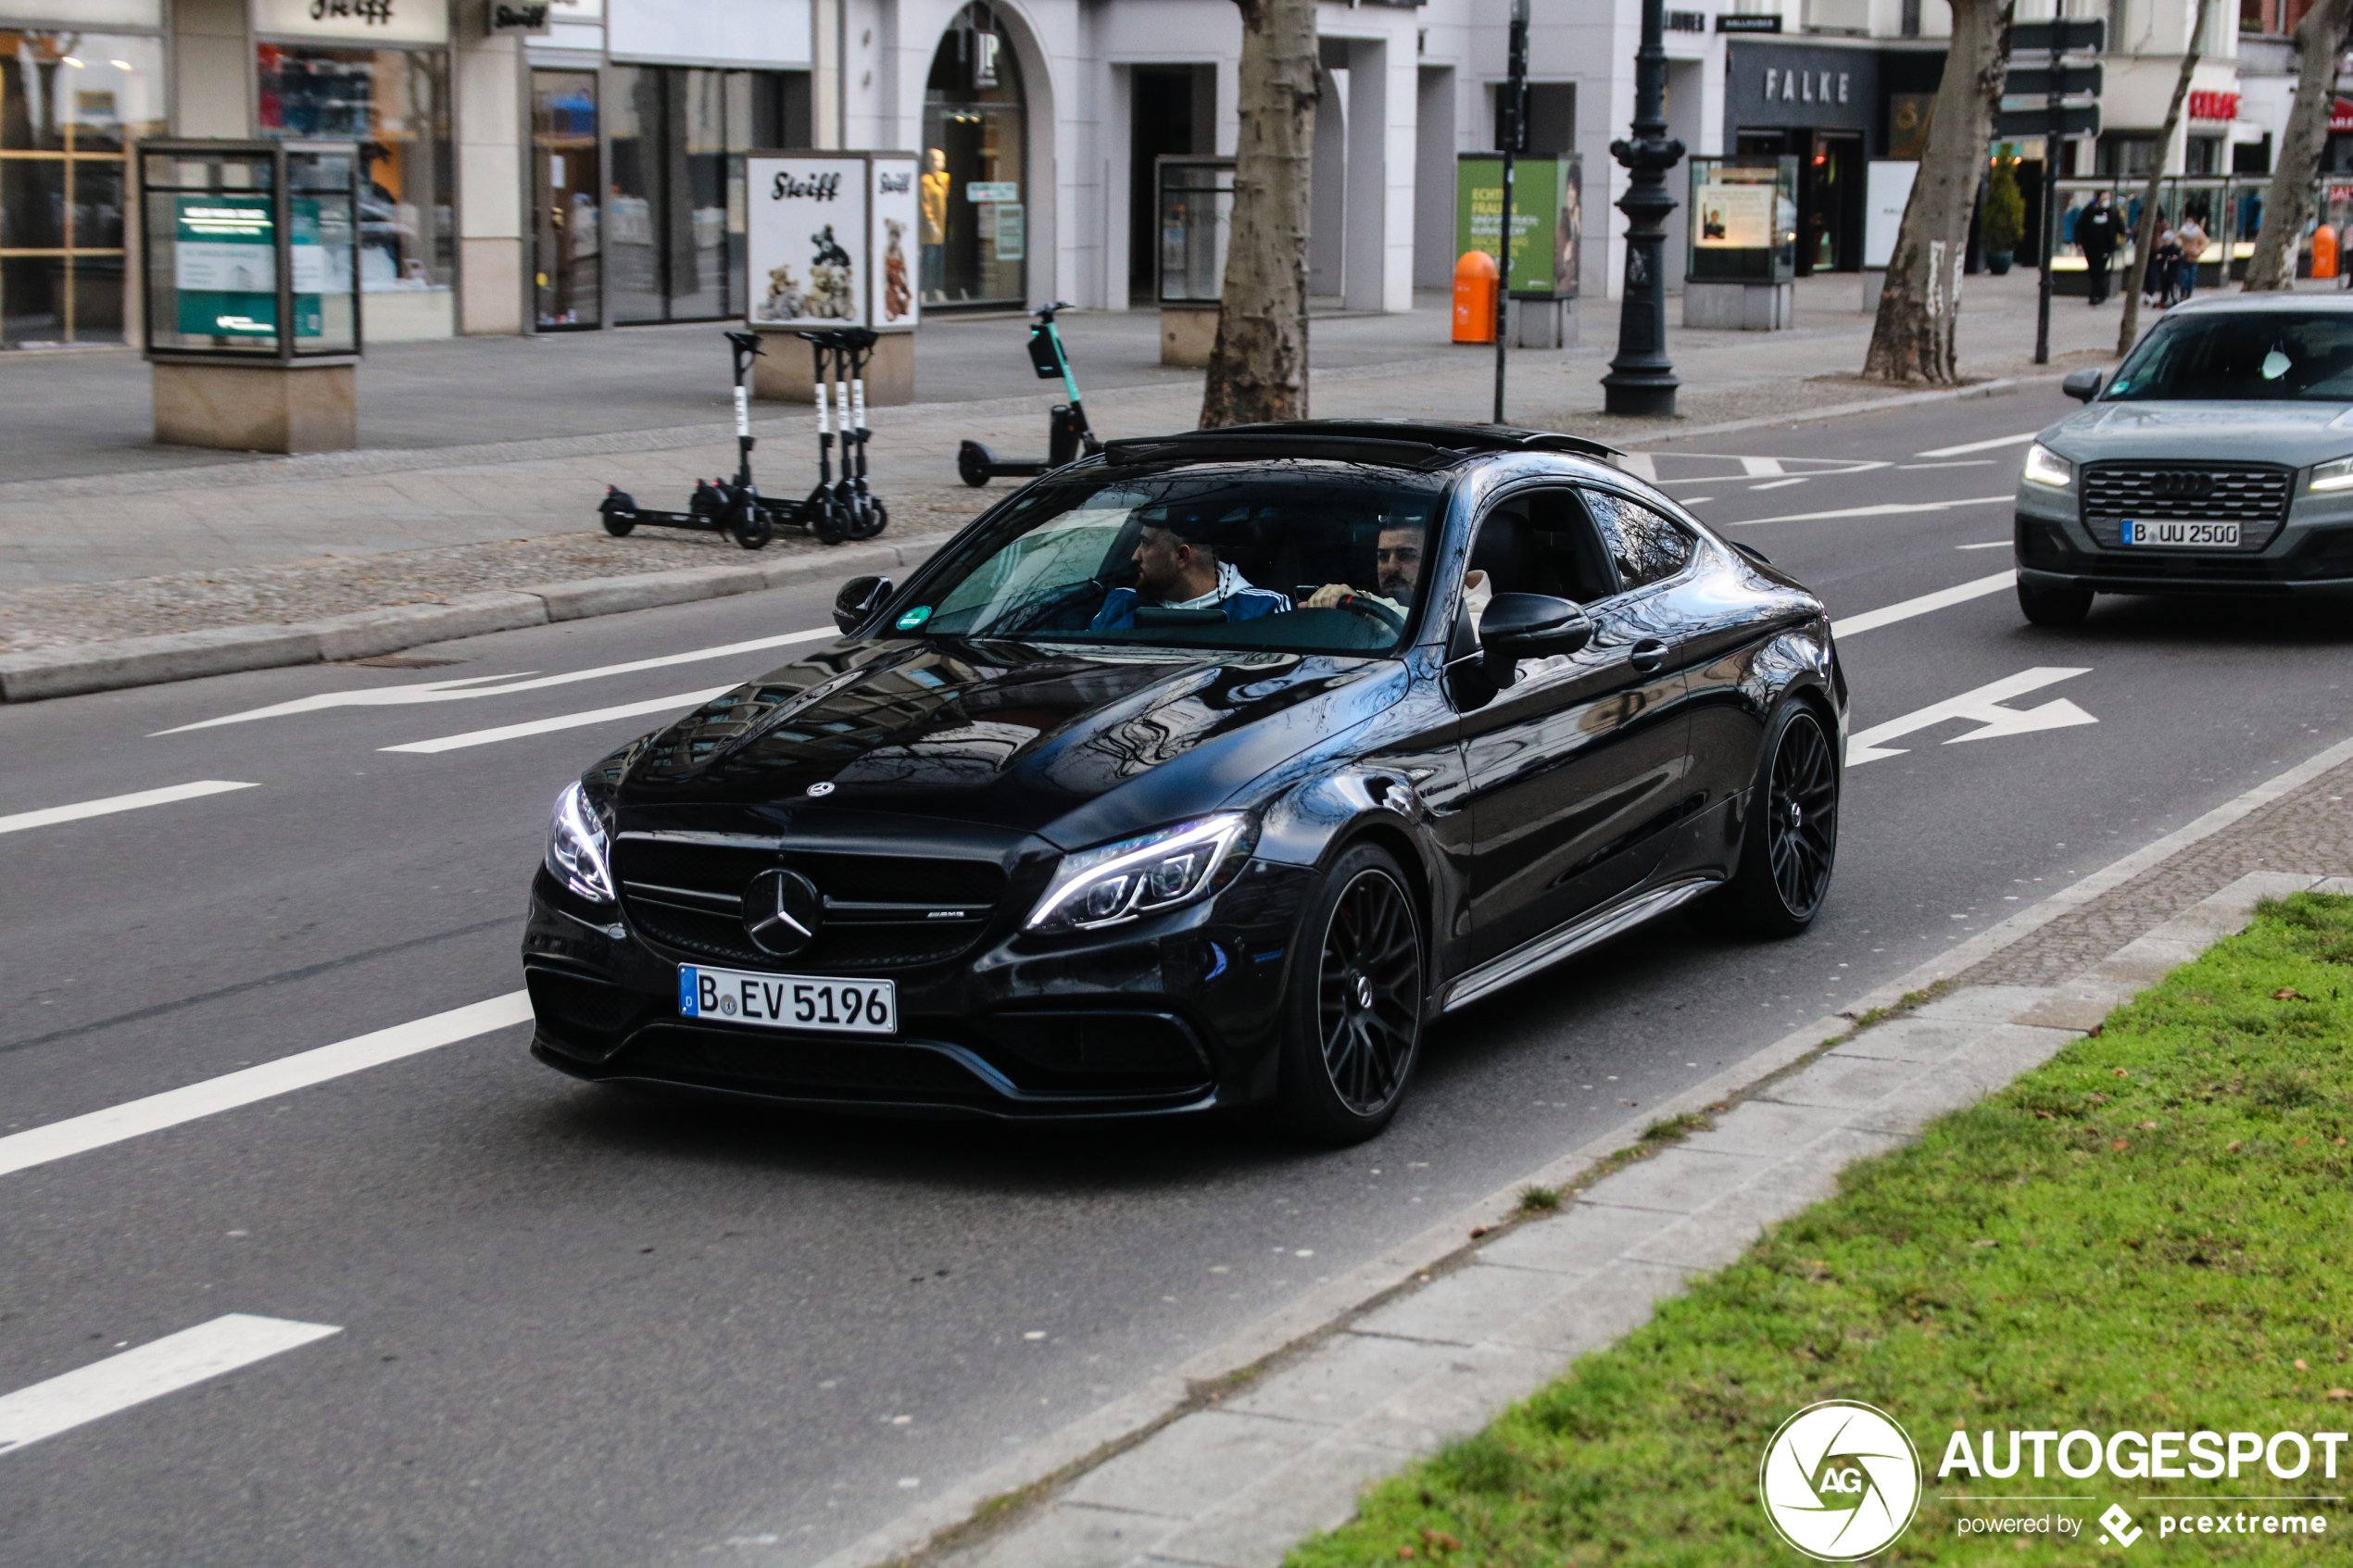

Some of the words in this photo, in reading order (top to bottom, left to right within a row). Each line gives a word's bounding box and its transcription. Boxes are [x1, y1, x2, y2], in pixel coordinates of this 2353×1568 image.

[1766, 67, 1850, 104] FALKE
[772, 171, 841, 201] Steiff
[2134, 524, 2146, 541] B
[2159, 524, 2184, 542] UU
[2189, 525, 2237, 543] 2500
[698, 974, 719, 1012] B
[740, 979, 784, 1020] EV
[793, 984, 887, 1025] 5196
